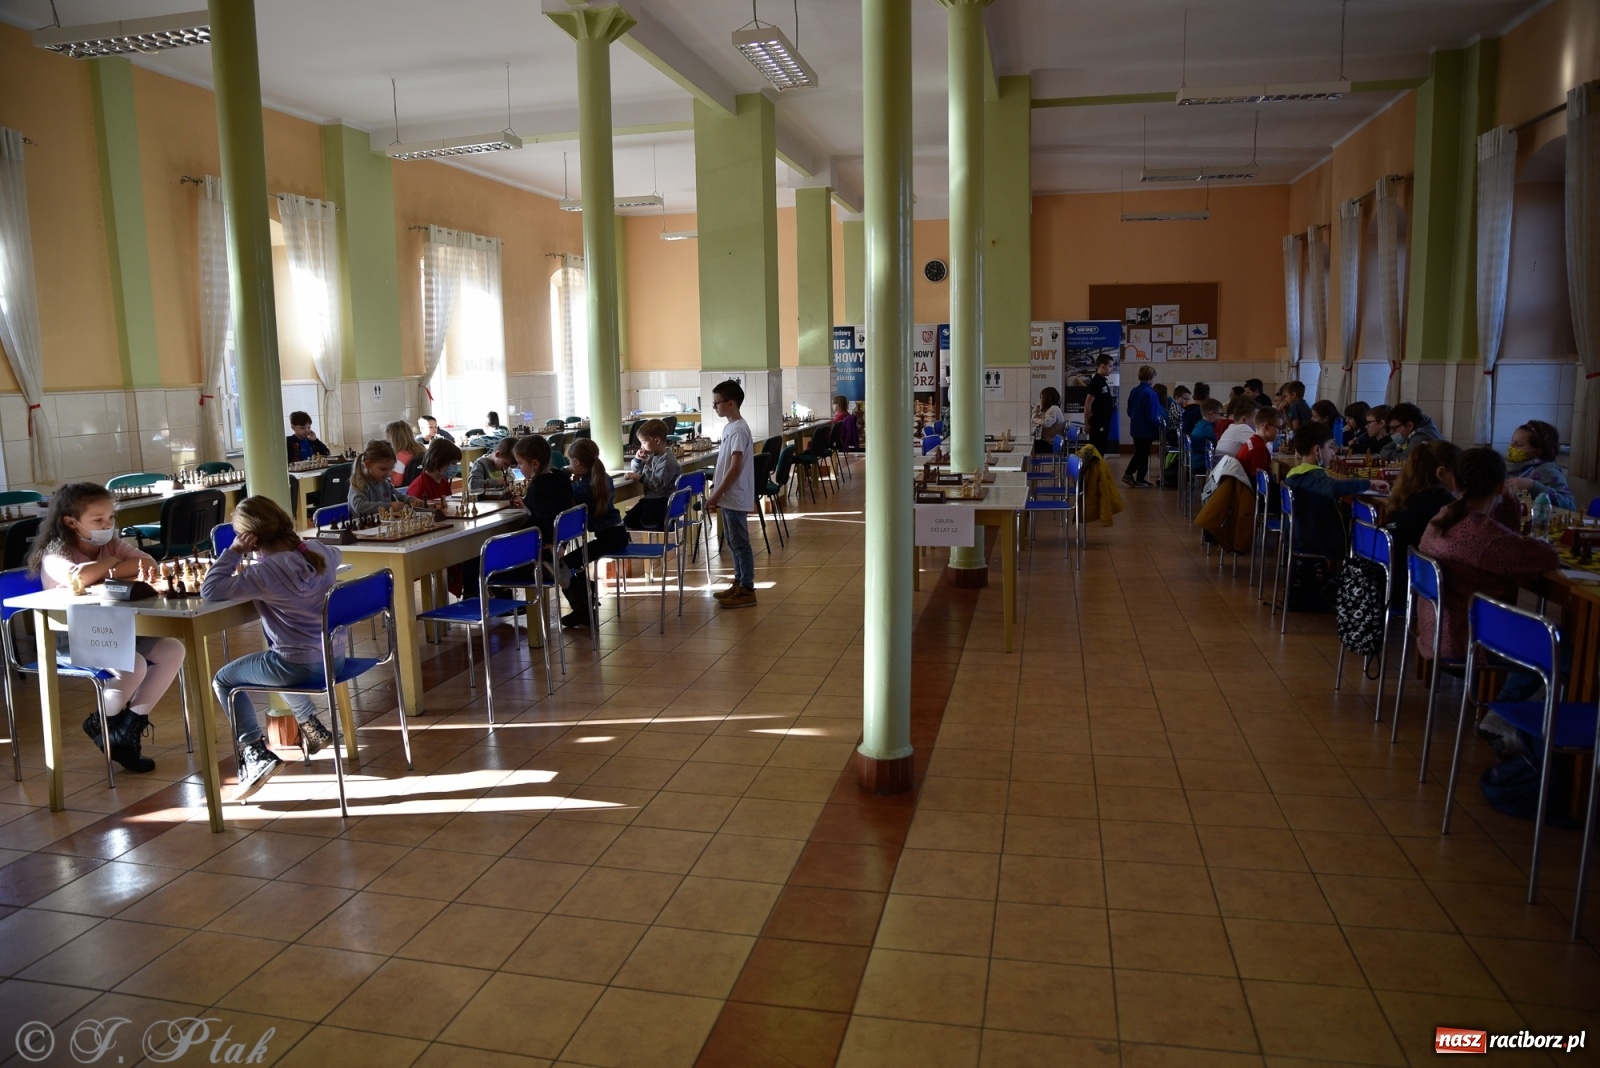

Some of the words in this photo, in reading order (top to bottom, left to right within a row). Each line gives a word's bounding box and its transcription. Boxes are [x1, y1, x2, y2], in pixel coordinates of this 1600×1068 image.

[834, 352, 865, 363] HOWY
[914, 350, 935, 358] HOWY
[91, 626, 114, 635] GRUPA
[90, 639, 101, 647] DO
[101, 640, 113, 648] LAT
[113, 640, 118, 649] 9
